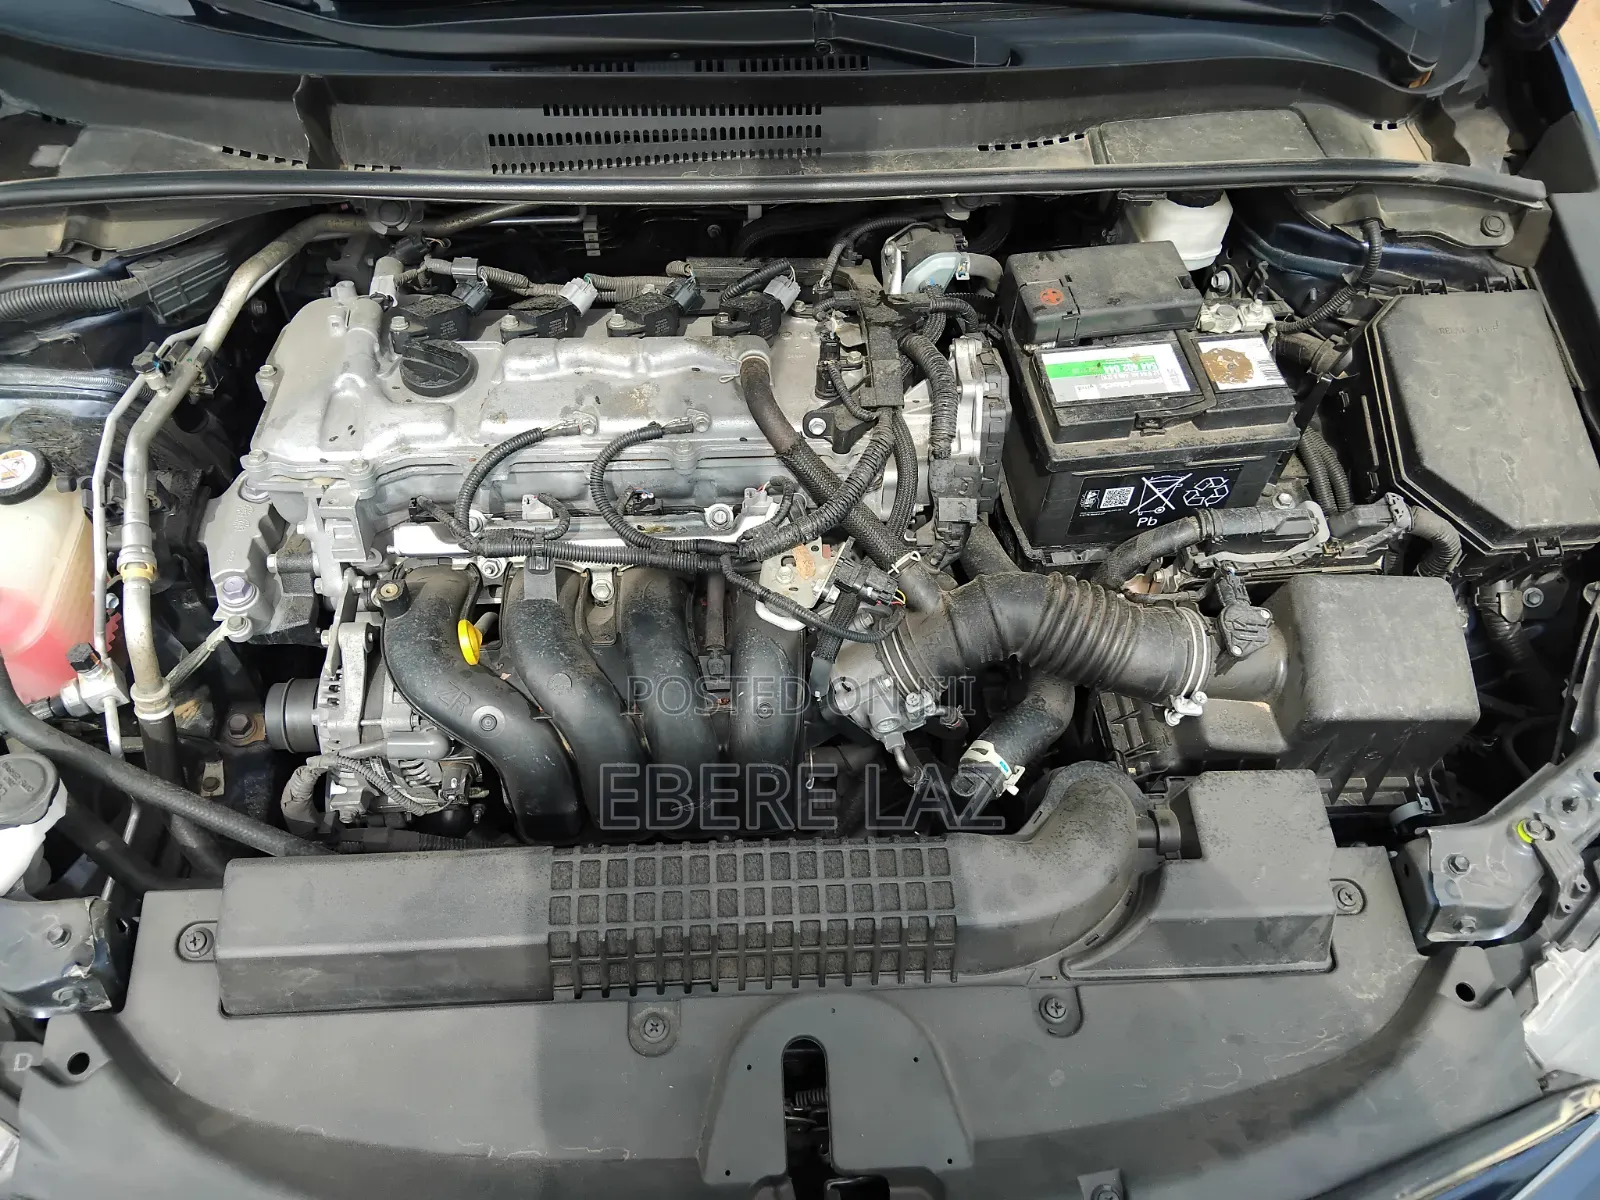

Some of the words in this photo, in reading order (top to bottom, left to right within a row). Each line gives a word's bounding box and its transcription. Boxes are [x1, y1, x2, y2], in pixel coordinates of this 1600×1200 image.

[1136, 516, 1158, 528] Pb
[437, 680, 472, 717] ZR
[13, 1052, 33, 1071] D
